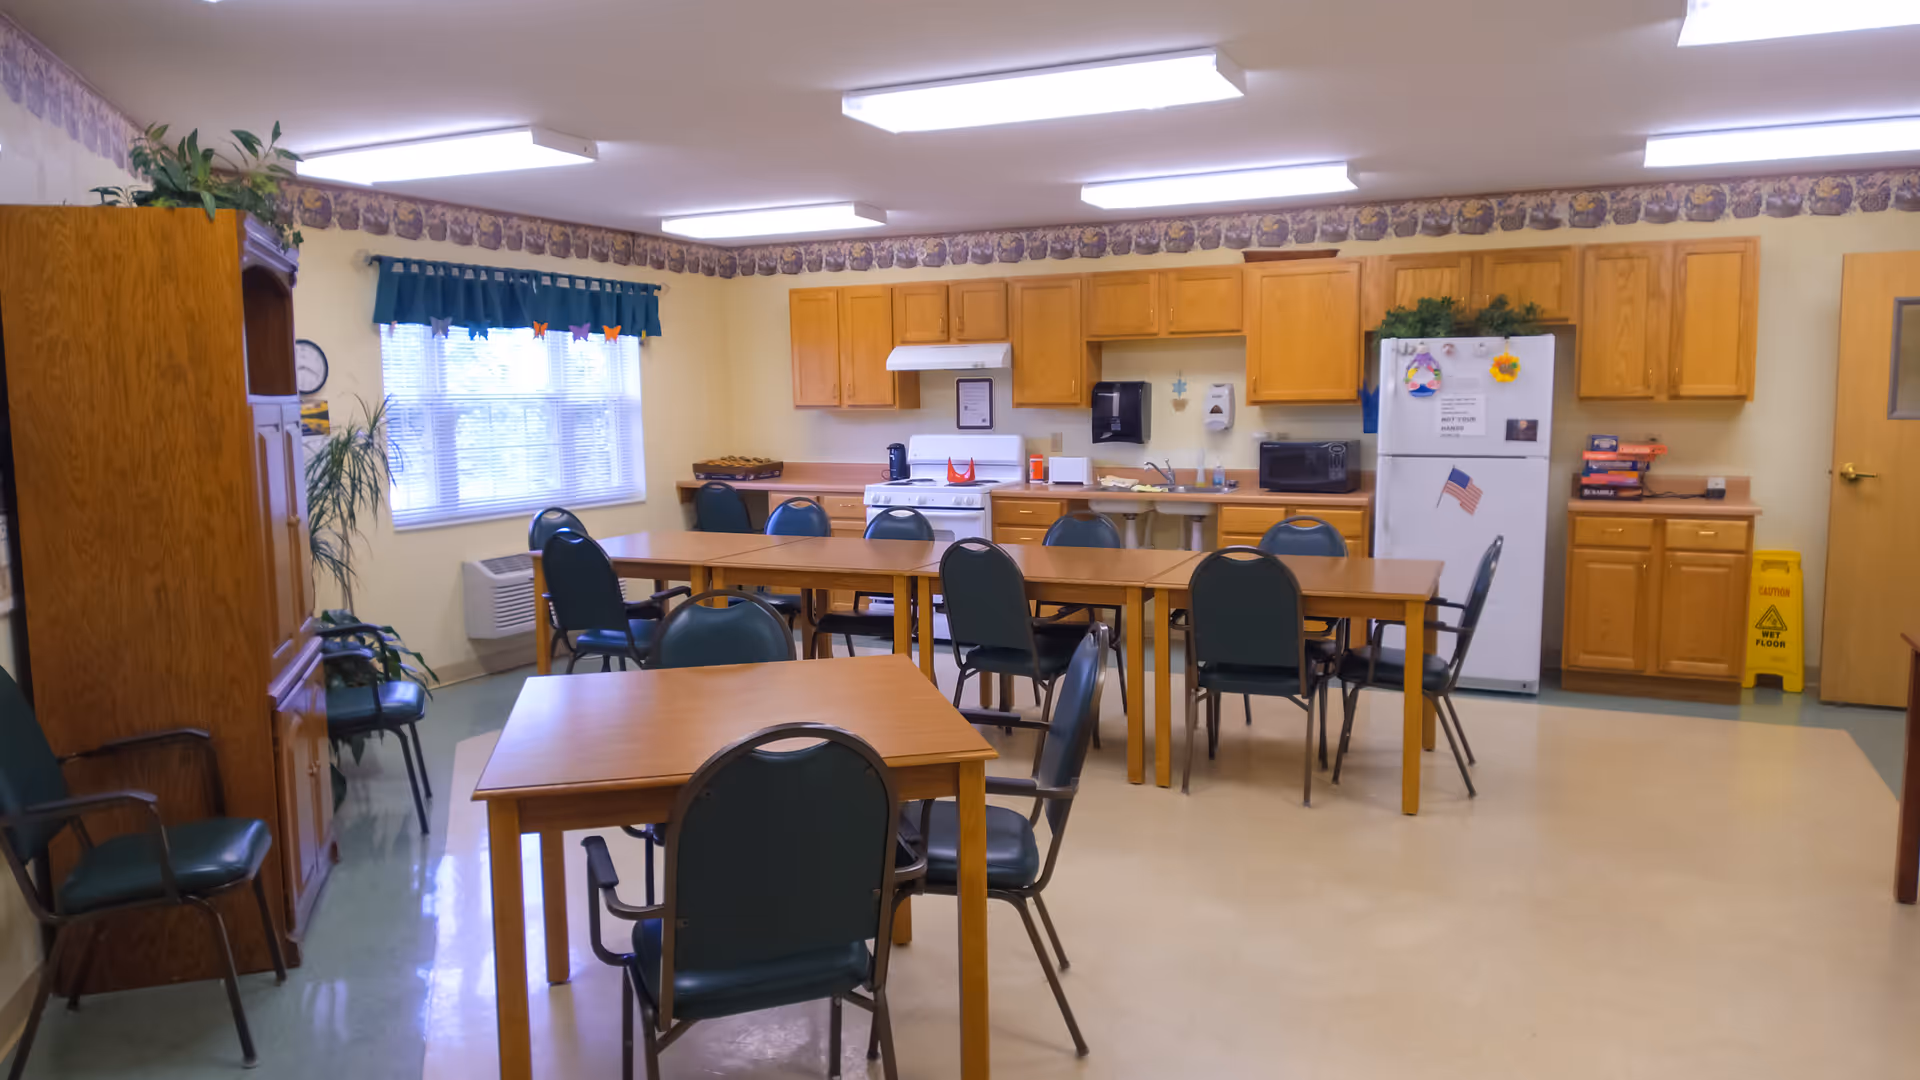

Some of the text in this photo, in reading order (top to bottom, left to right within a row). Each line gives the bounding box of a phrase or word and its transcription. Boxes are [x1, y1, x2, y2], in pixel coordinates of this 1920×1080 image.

[1758, 585, 1791, 598] CAUTION
[1761, 630, 1781, 639] WET
[1755, 639, 1786, 649] FLOOR
